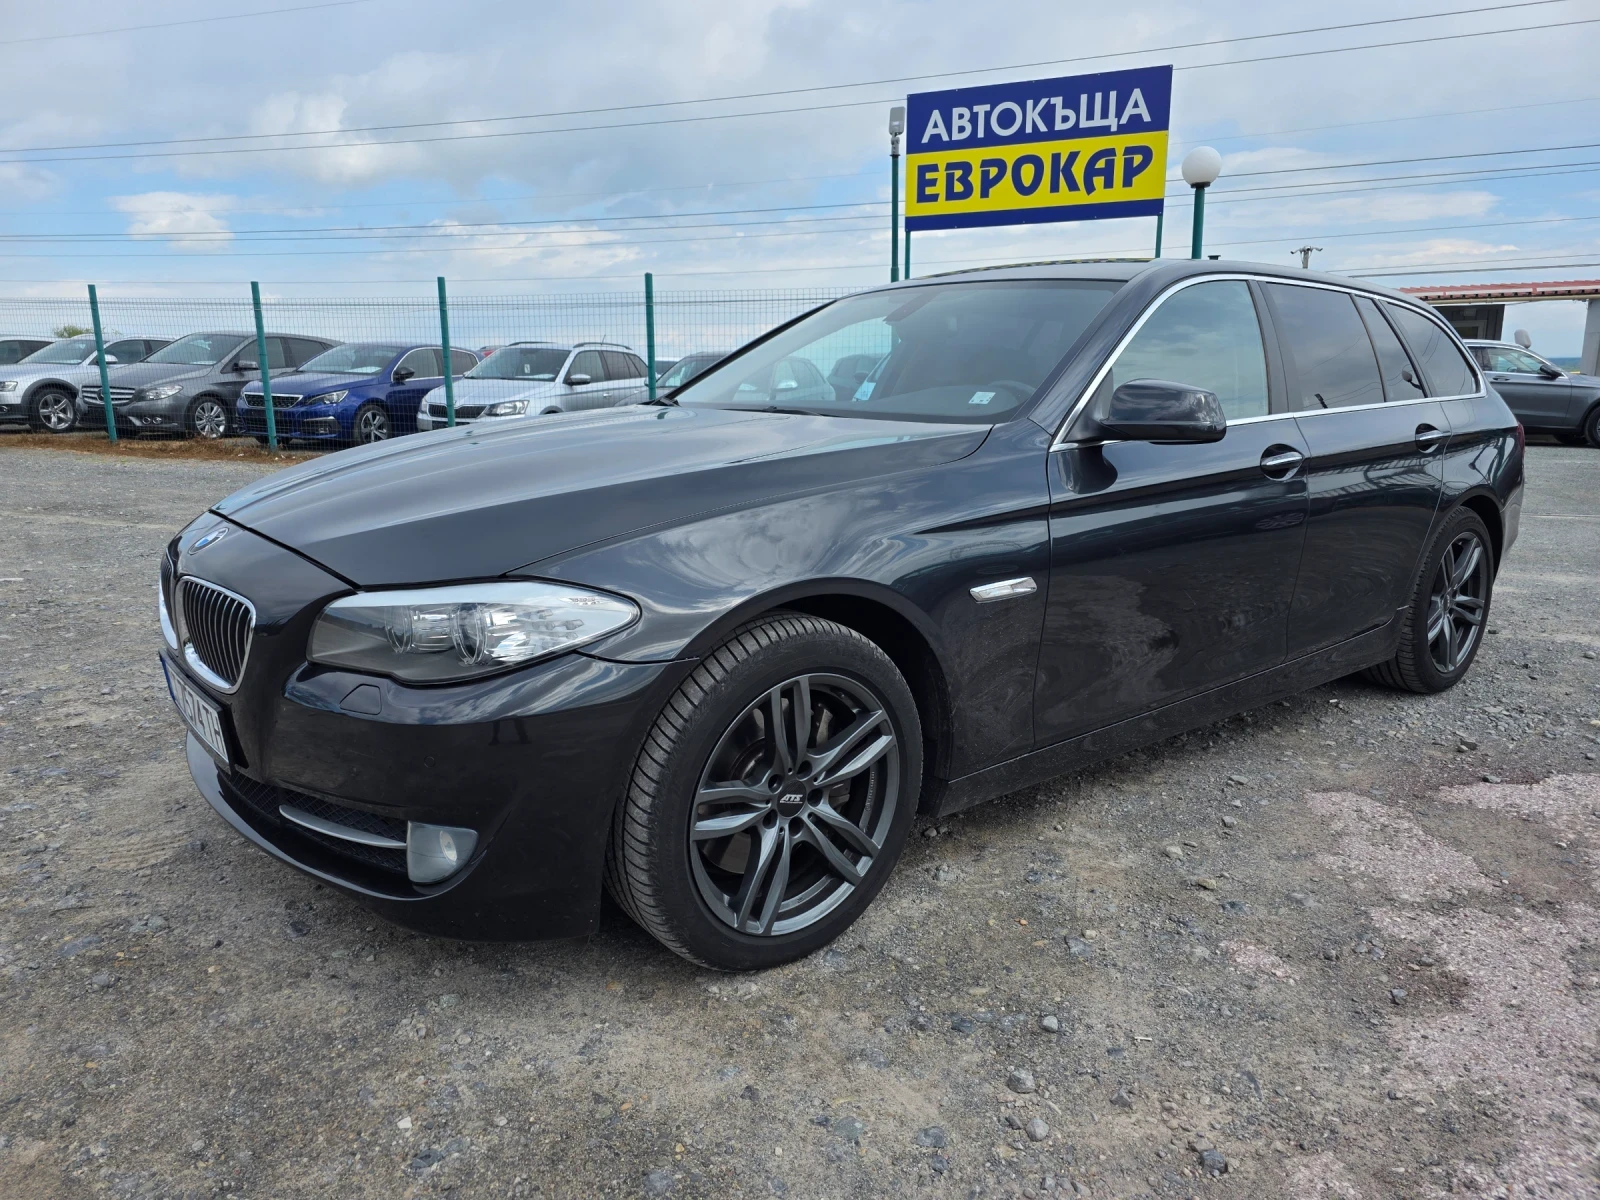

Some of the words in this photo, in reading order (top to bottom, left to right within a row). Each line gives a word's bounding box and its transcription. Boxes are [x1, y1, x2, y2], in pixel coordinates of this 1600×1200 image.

[921, 88, 1151, 143] АВТОКЪЩА
[916, 145, 1154, 204] ЕВРОКАР
[779, 793, 803, 804] ATS
